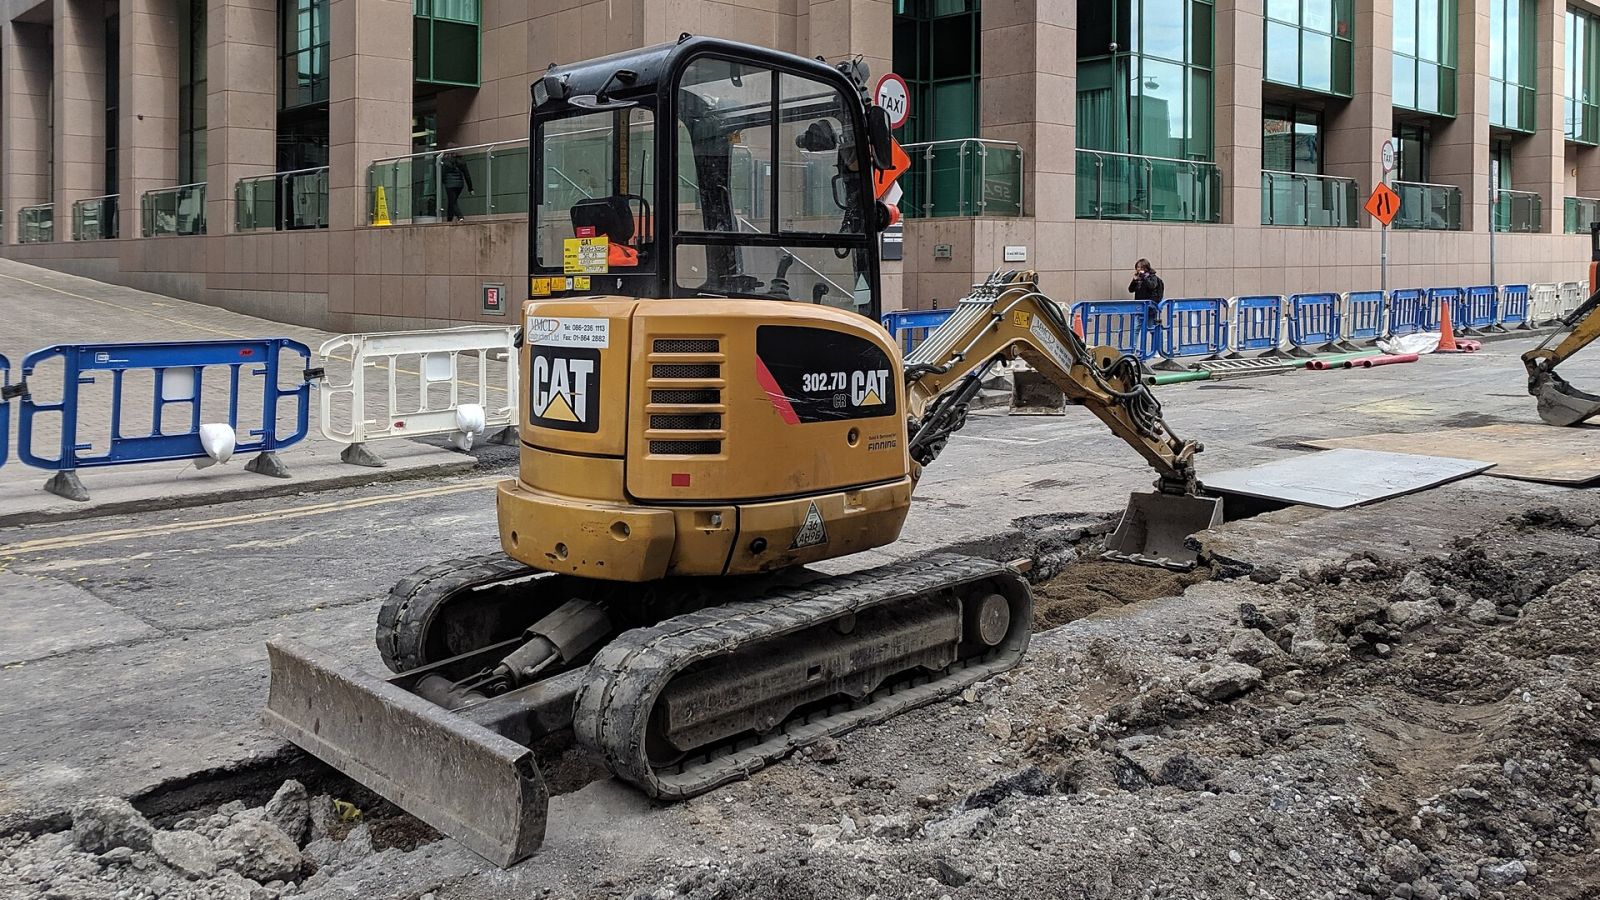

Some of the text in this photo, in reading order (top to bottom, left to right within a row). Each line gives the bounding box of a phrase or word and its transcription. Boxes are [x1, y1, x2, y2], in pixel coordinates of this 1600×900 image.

[881, 94, 904, 114] TAXI
[533, 355, 594, 423] CAT
[802, 371, 847, 392] 302.7D
[851, 369, 889, 407] CAT
[833, 393, 847, 409] CR
